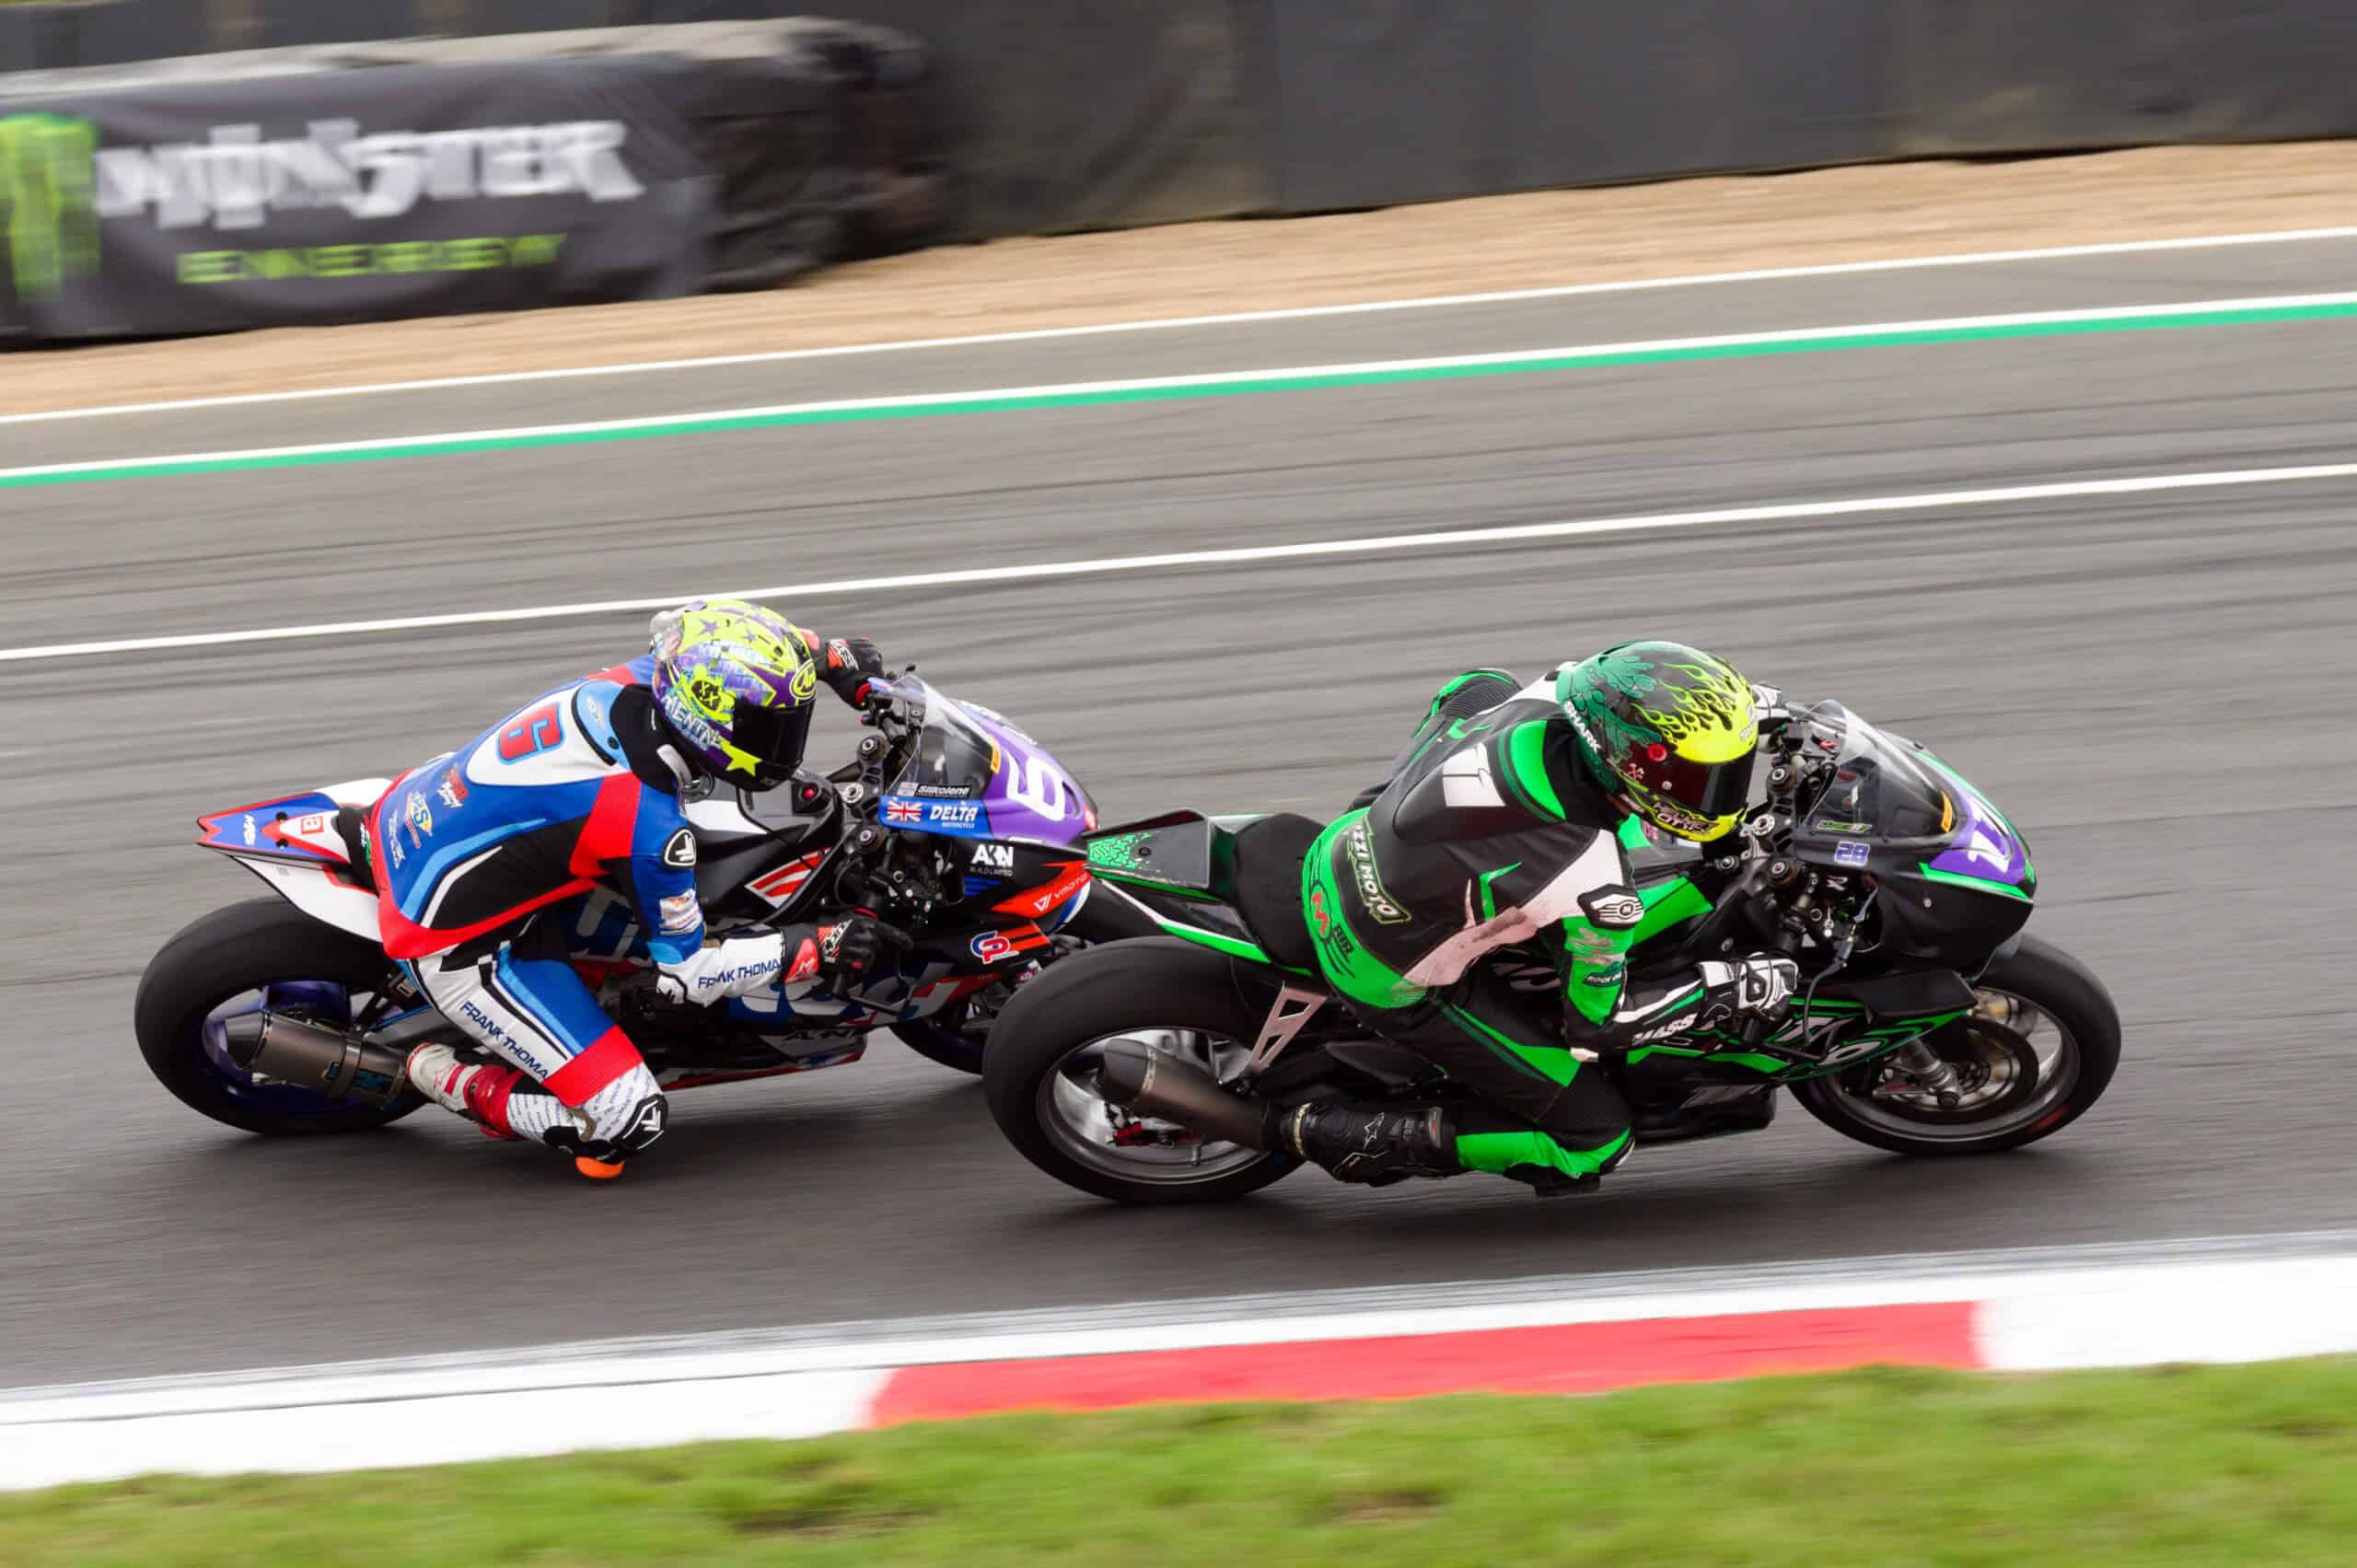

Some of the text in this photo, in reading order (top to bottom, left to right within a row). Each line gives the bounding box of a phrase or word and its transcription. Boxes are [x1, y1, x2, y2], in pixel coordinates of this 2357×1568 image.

[95, 117, 643, 229] MONSTER
[177, 234, 567, 284] ENERGY
[496, 702, 565, 765] 6
[1564, 700, 1602, 753] SHARK
[929, 805, 980, 822] DELTA
[1834, 841, 1871, 867] 28
[1358, 861, 1400, 917] MOTO
[460, 1001, 504, 1040] FRANK
